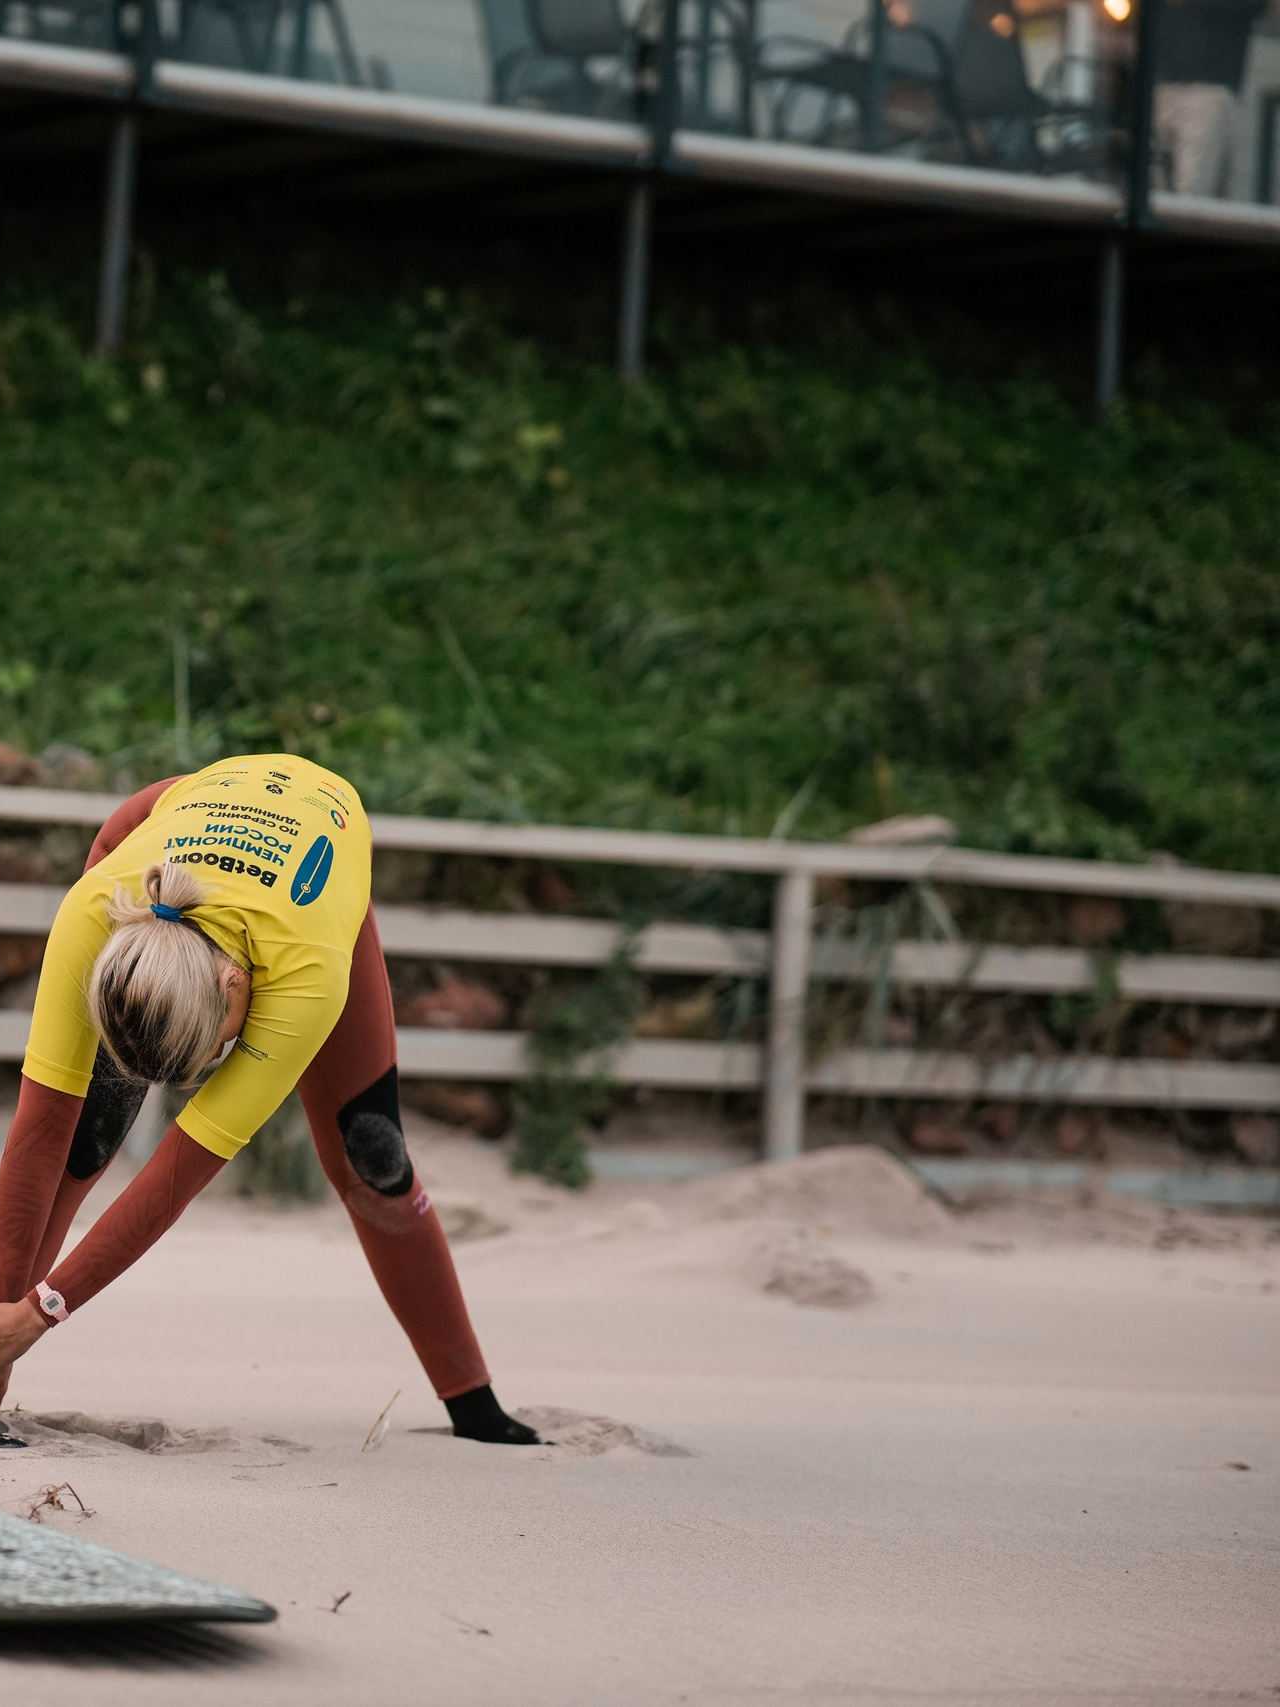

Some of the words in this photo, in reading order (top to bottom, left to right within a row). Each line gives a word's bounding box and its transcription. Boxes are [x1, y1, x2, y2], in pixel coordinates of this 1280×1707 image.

[206, 811, 277, 828] СЕРФИНГУ
[231, 804, 302, 827] «ДЛИННАЯ
[205, 823, 292, 854] РОССИИ
[279, 825, 299, 837] ПО
[163, 836, 285, 867] ЧЕМПИОНАТ
